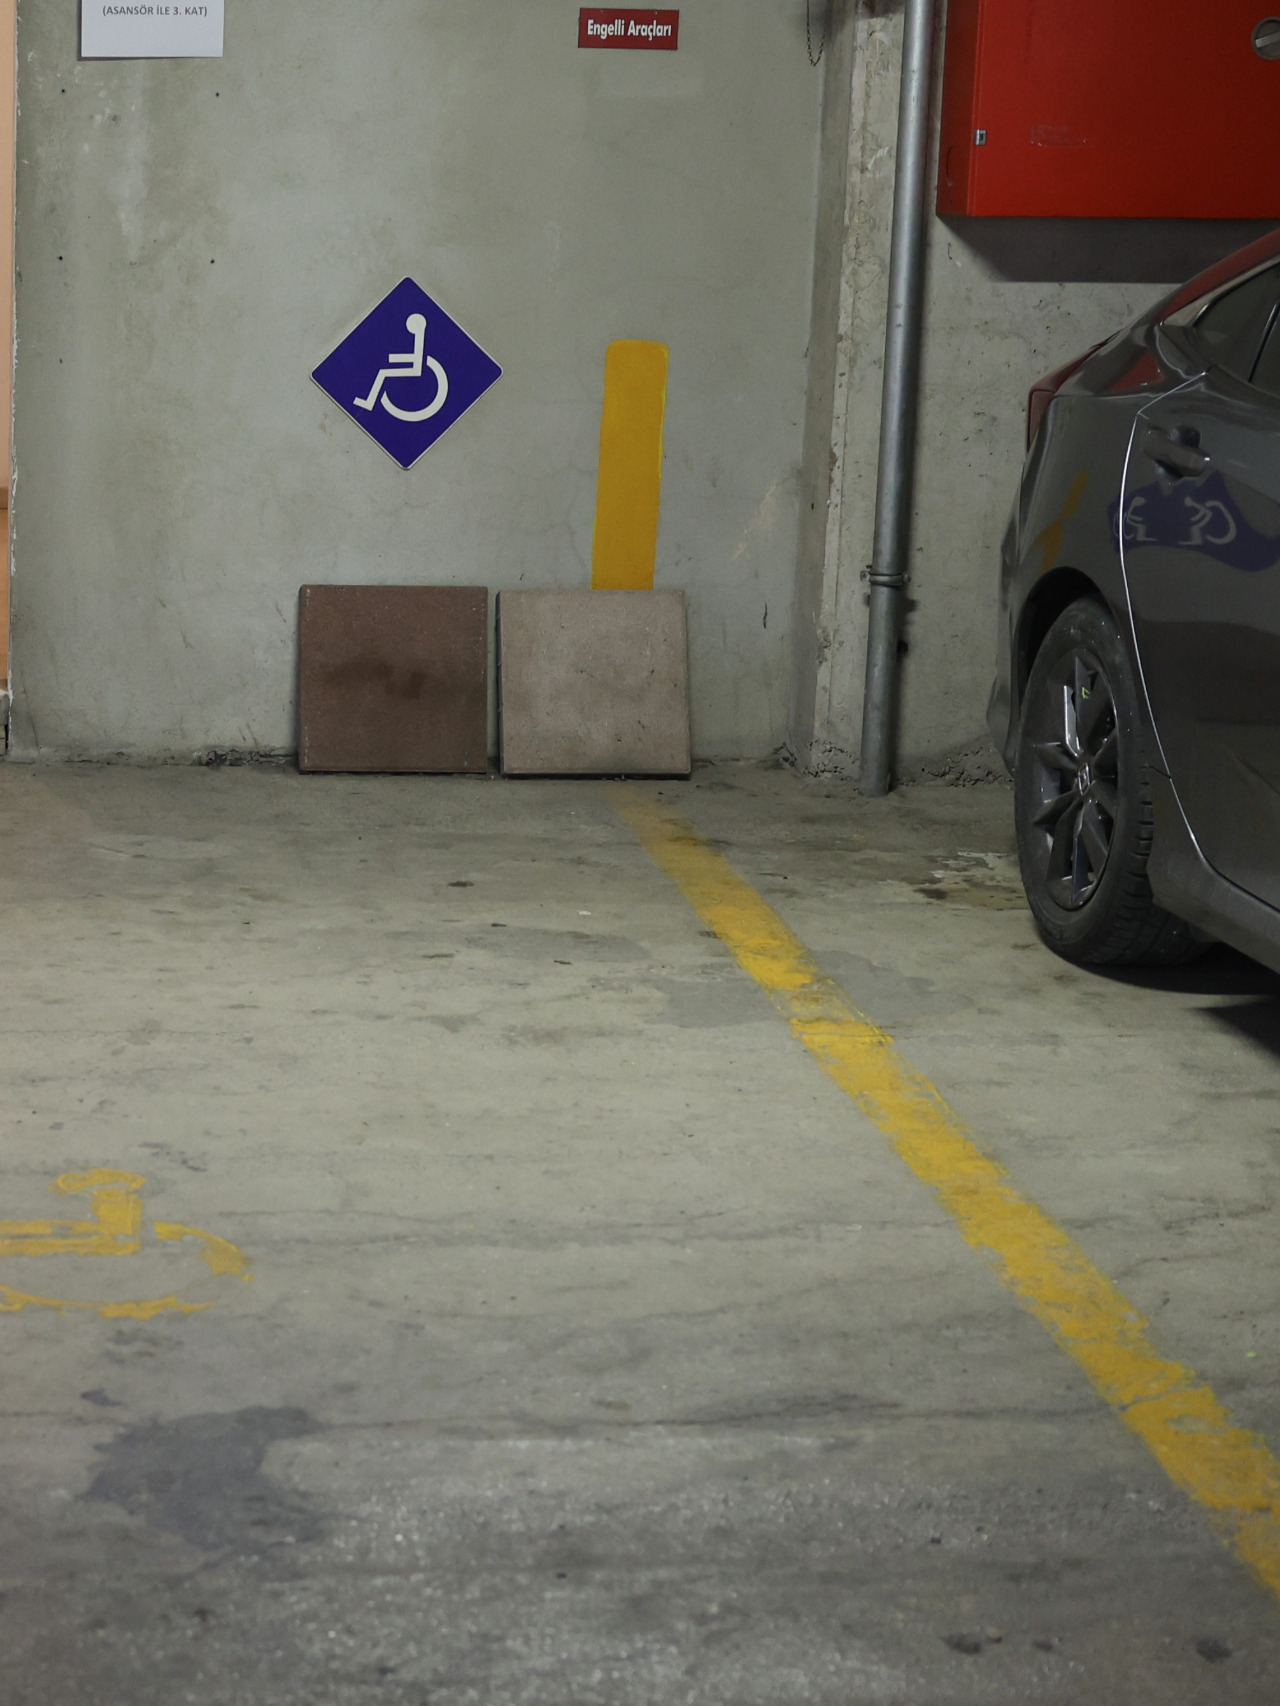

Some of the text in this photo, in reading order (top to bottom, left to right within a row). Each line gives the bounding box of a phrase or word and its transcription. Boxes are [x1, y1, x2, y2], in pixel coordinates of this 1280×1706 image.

[103, 4, 208, 17] (ASANSÖR İLE 3. KAT)
[587, 19, 672, 41] Engelli Araçları
